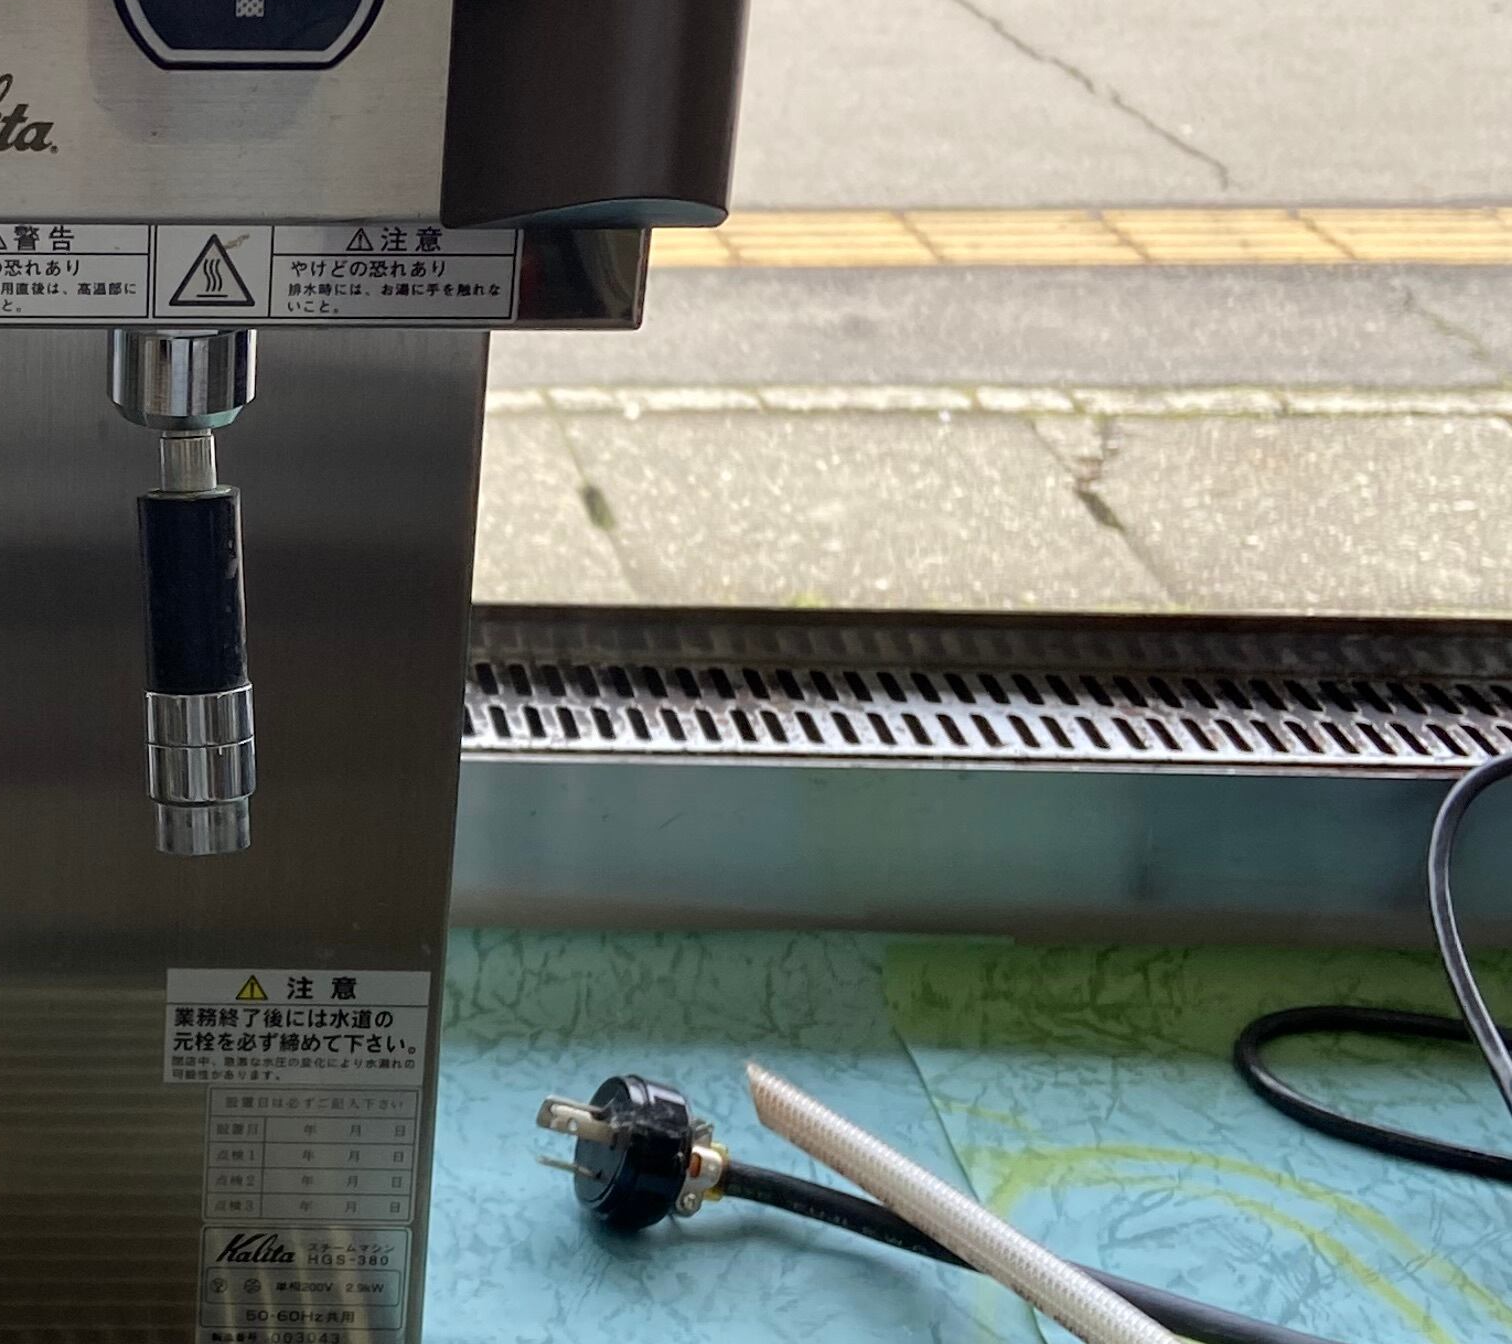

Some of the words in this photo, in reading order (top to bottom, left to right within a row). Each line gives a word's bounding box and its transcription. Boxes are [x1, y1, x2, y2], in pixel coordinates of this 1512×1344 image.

[14, 226, 74, 251] 警告
[381, 226, 442, 252] 注意
[291, 260, 446, 278] やけどの恐れあり
[288, 300, 338, 314] いこと。
[287, 976, 357, 1000] 注意
[174, 1008, 393, 1029] 業務終了後には水道の
[173, 1032, 416, 1055] 元栓を必ず締めて下さい。
[216, 1233, 296, 1264] Kalita
[308, 1255, 389, 1266] HGS-380
